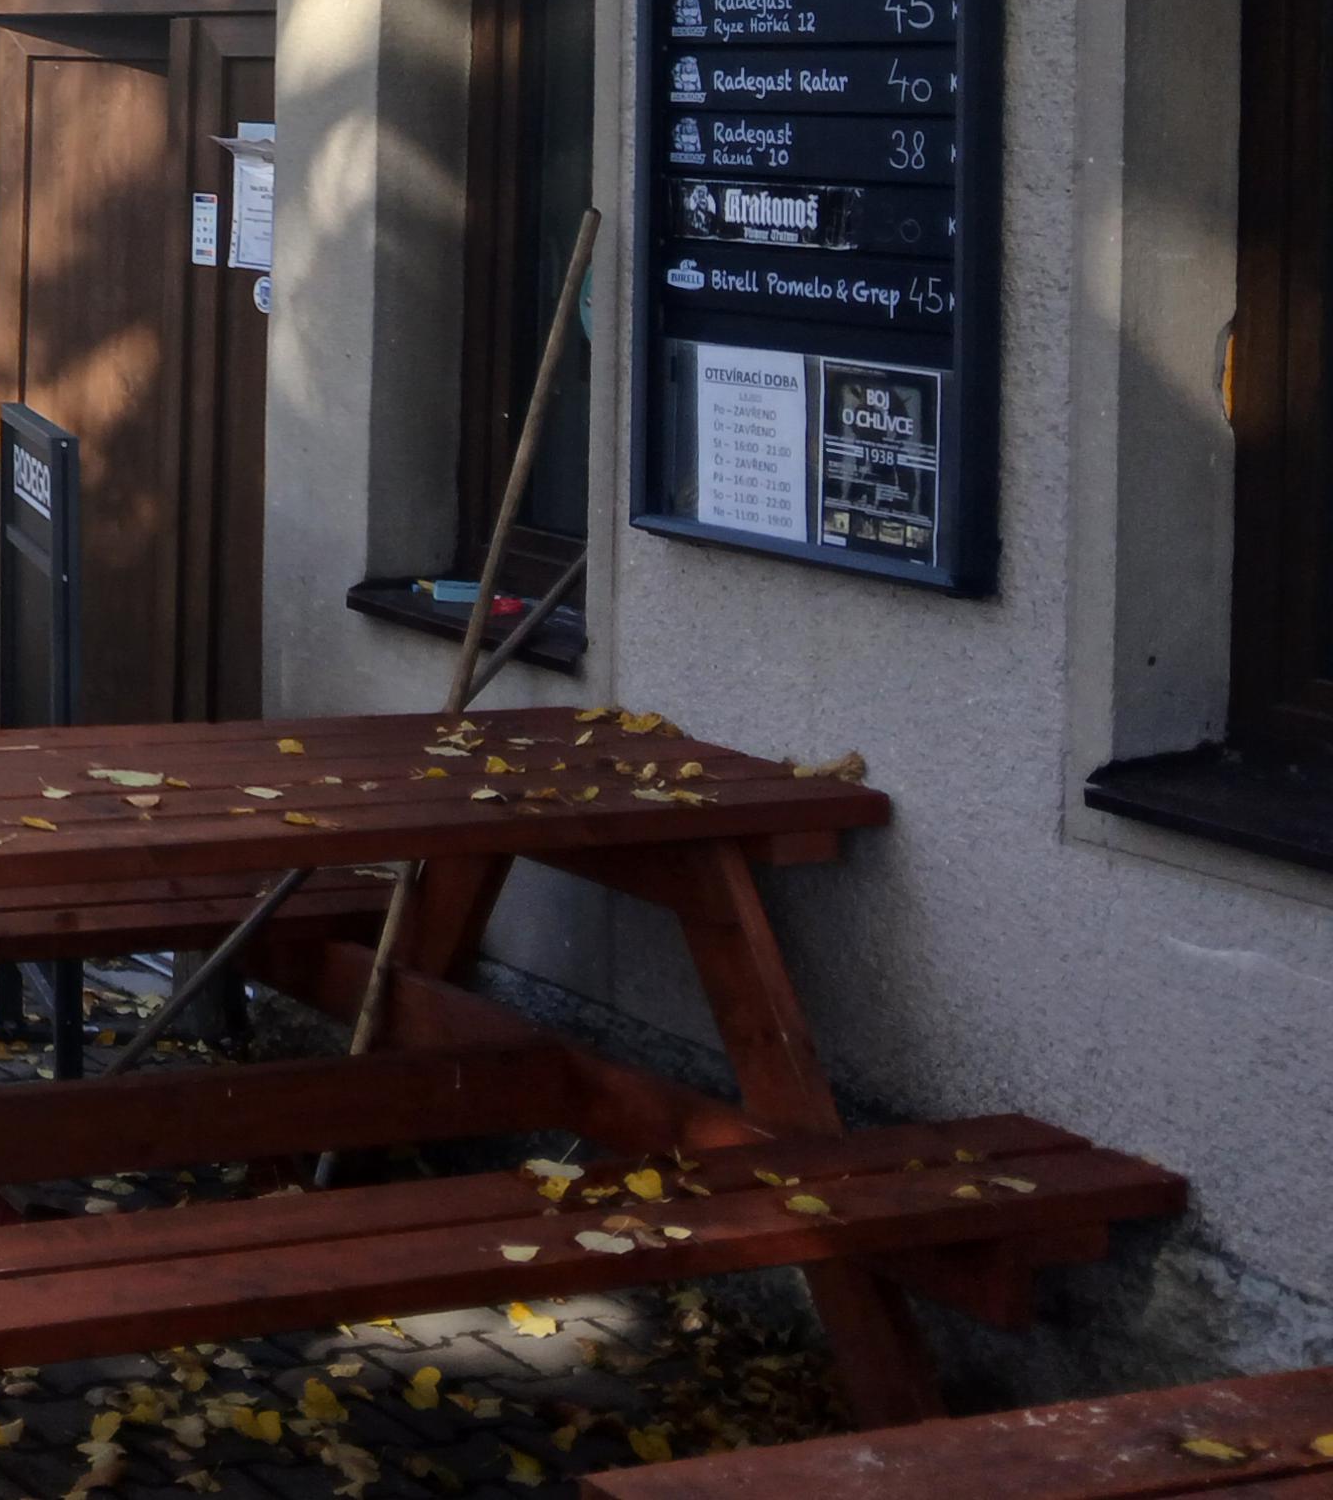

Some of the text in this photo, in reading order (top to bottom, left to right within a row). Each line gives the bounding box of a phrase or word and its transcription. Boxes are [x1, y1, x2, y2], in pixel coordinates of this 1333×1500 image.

[713, 19, 744, 42] Ryze
[749, 15, 791, 33] Hořká
[798, 12, 815, 32] 12
[713, 68, 793, 100] Radegast
[800, 69, 849, 93] Ratar
[887, 58, 933, 103] 40
[713, 119, 793, 152] Radegast
[889, 130, 925, 169] 38
[712, 146, 754, 166] Rázná
[768, 148, 789, 166] 10
[724, 188, 819, 230] Krakonoš
[670, 273, 702, 285] BIRELL
[711, 270, 759, 294] Birell
[767, 276, 832, 299] Pomelo
[836, 281, 848, 304] &
[852, 283, 901, 319] Grep
[909, 276, 944, 314] 45
[704, 367, 799, 389] OTEVÍRACÍ DOBA
[866, 388, 890, 410] BOJ
[733, 405, 777, 420] ZAVŘENO
[842, 408, 854, 425] O
[733, 423, 777, 438] ZAVŘENO
[735, 457, 778, 473] ZAVŘENO
[865, 447, 894, 465] 1938
[13, 443, 51, 508] RADEGA
